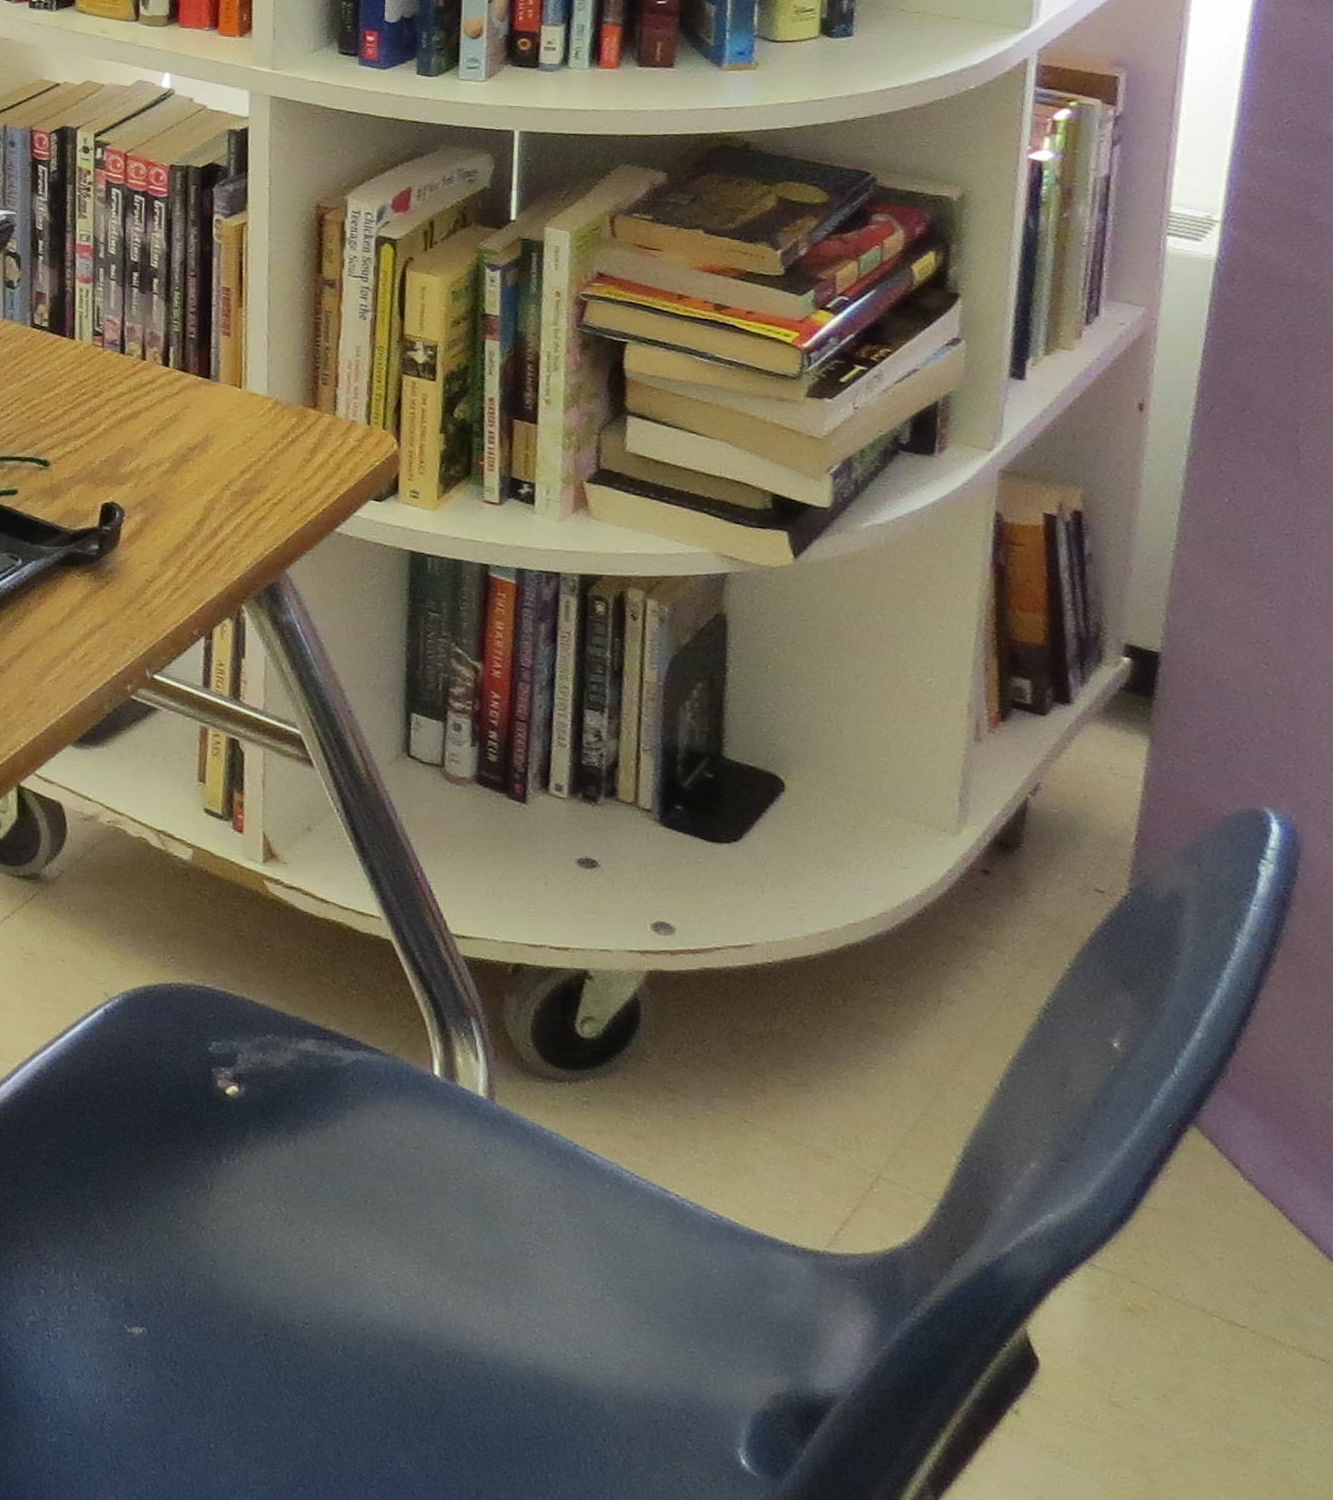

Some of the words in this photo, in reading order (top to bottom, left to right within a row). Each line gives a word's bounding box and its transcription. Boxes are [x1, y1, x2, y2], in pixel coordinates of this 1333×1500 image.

[348, 209, 361, 251] Teenage
[361, 211, 374, 253] Chicken
[347, 254, 361, 278] Soul
[358, 255, 372, 283] Soup
[359, 285, 370, 301] for
[358, 303, 370, 321] the
[496, 590, 507, 614] THE
[490, 620, 505, 679] MARTIAN
[488, 690, 501, 725] ANDY
[486, 731, 498, 762] WEIR
